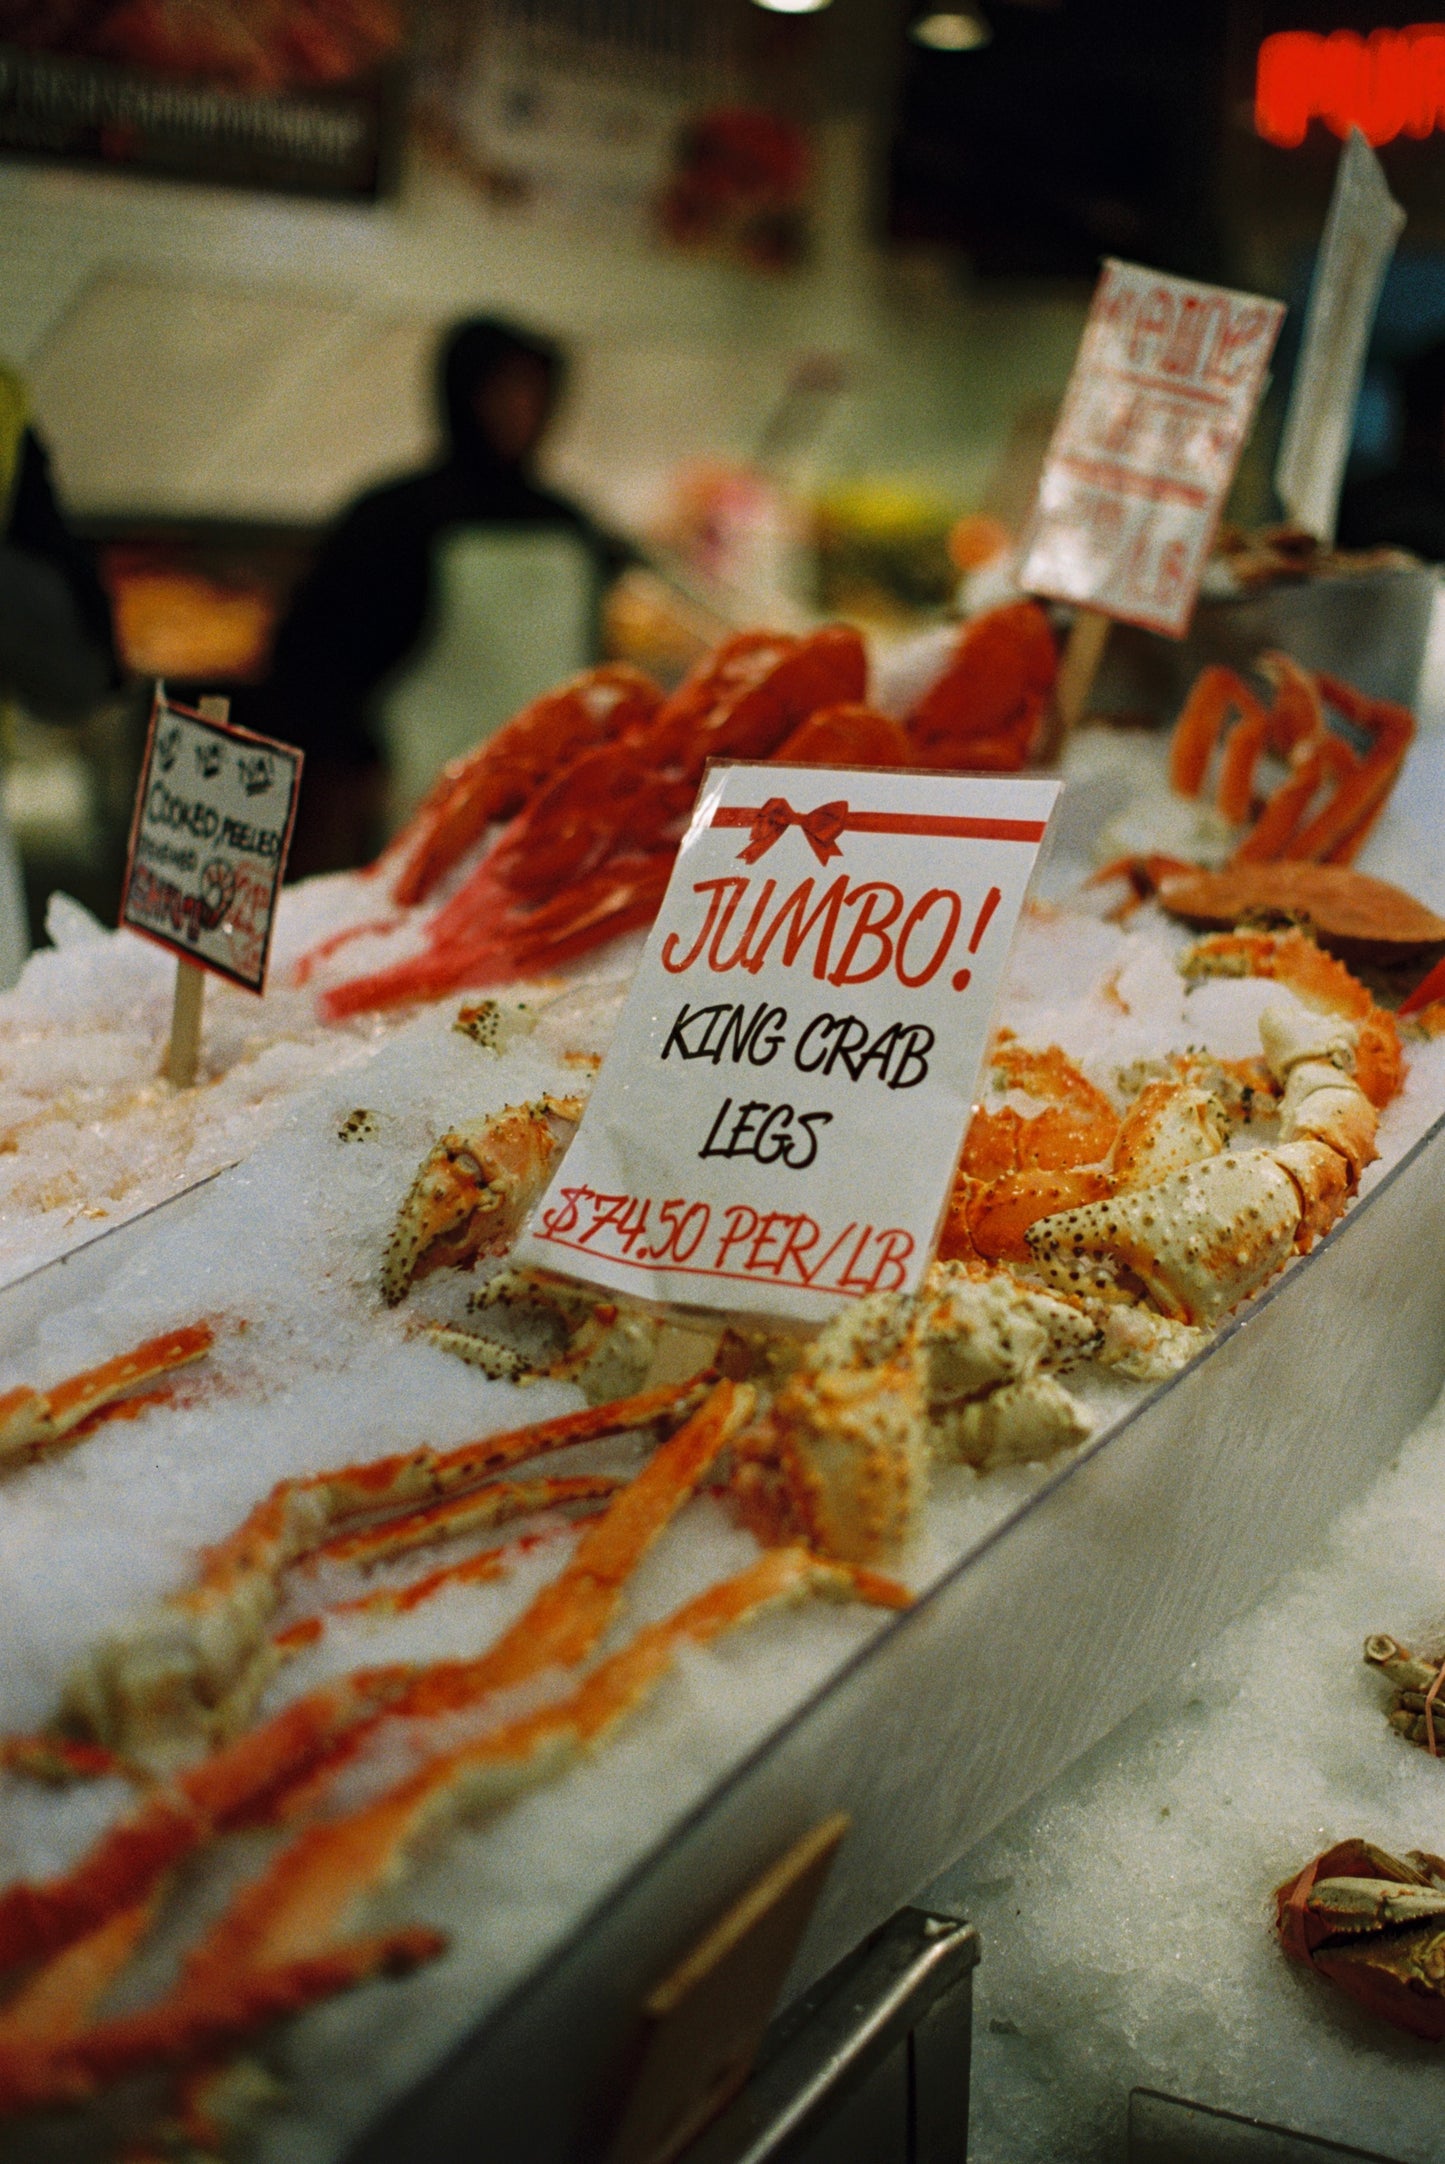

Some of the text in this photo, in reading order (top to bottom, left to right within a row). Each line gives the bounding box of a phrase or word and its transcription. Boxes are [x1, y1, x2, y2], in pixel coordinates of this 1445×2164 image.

[661, 874, 1001, 992] JUMBO!
[661, 1001, 935, 1089] KING CRAB
[698, 1097, 833, 1169] LEGS
[542, 1184, 915, 1294] $74.50 PER/LB
